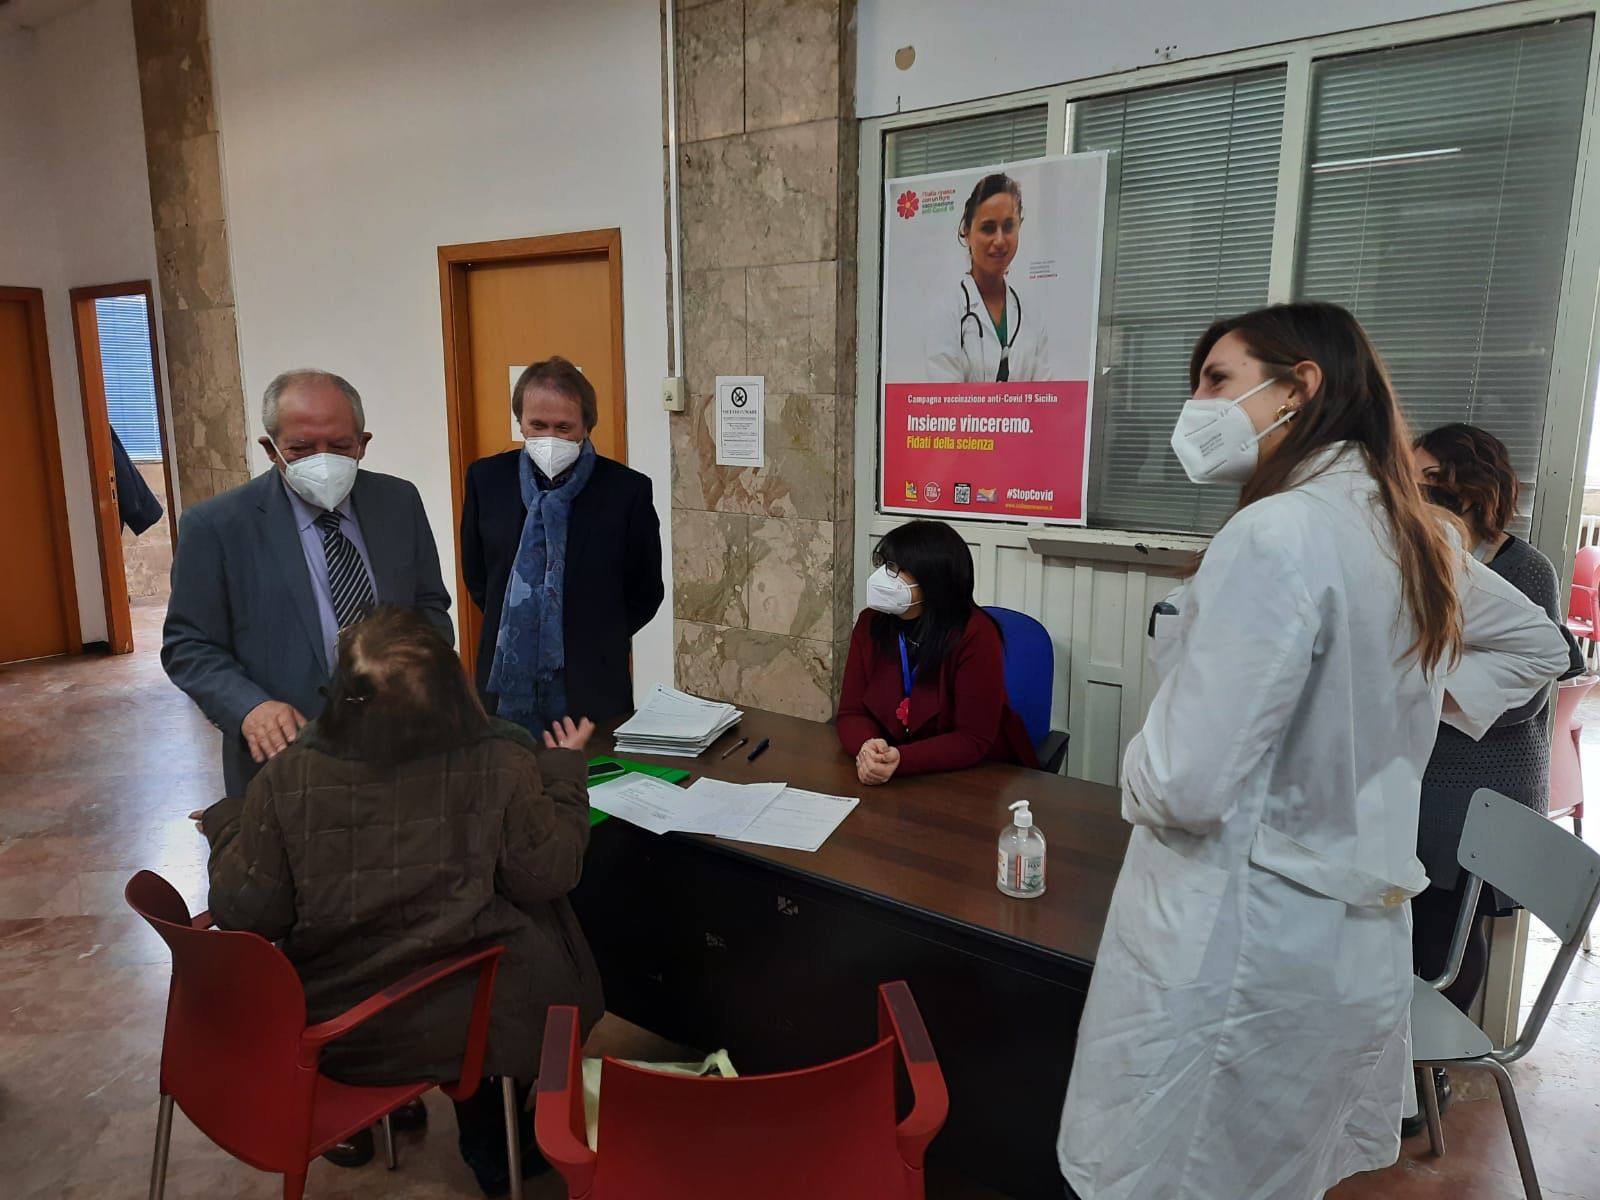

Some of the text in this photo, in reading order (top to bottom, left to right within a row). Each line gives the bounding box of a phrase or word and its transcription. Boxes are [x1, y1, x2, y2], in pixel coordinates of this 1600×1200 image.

[907, 393, 1058, 405] Campagna vaccinazione anti-Covid 19 Sicilia
[907, 414, 1033, 433] Insieme vinceremo.
[906, 435, 994, 451] Fidati della scienza
[1006, 488, 1054, 502] #StopCovid
